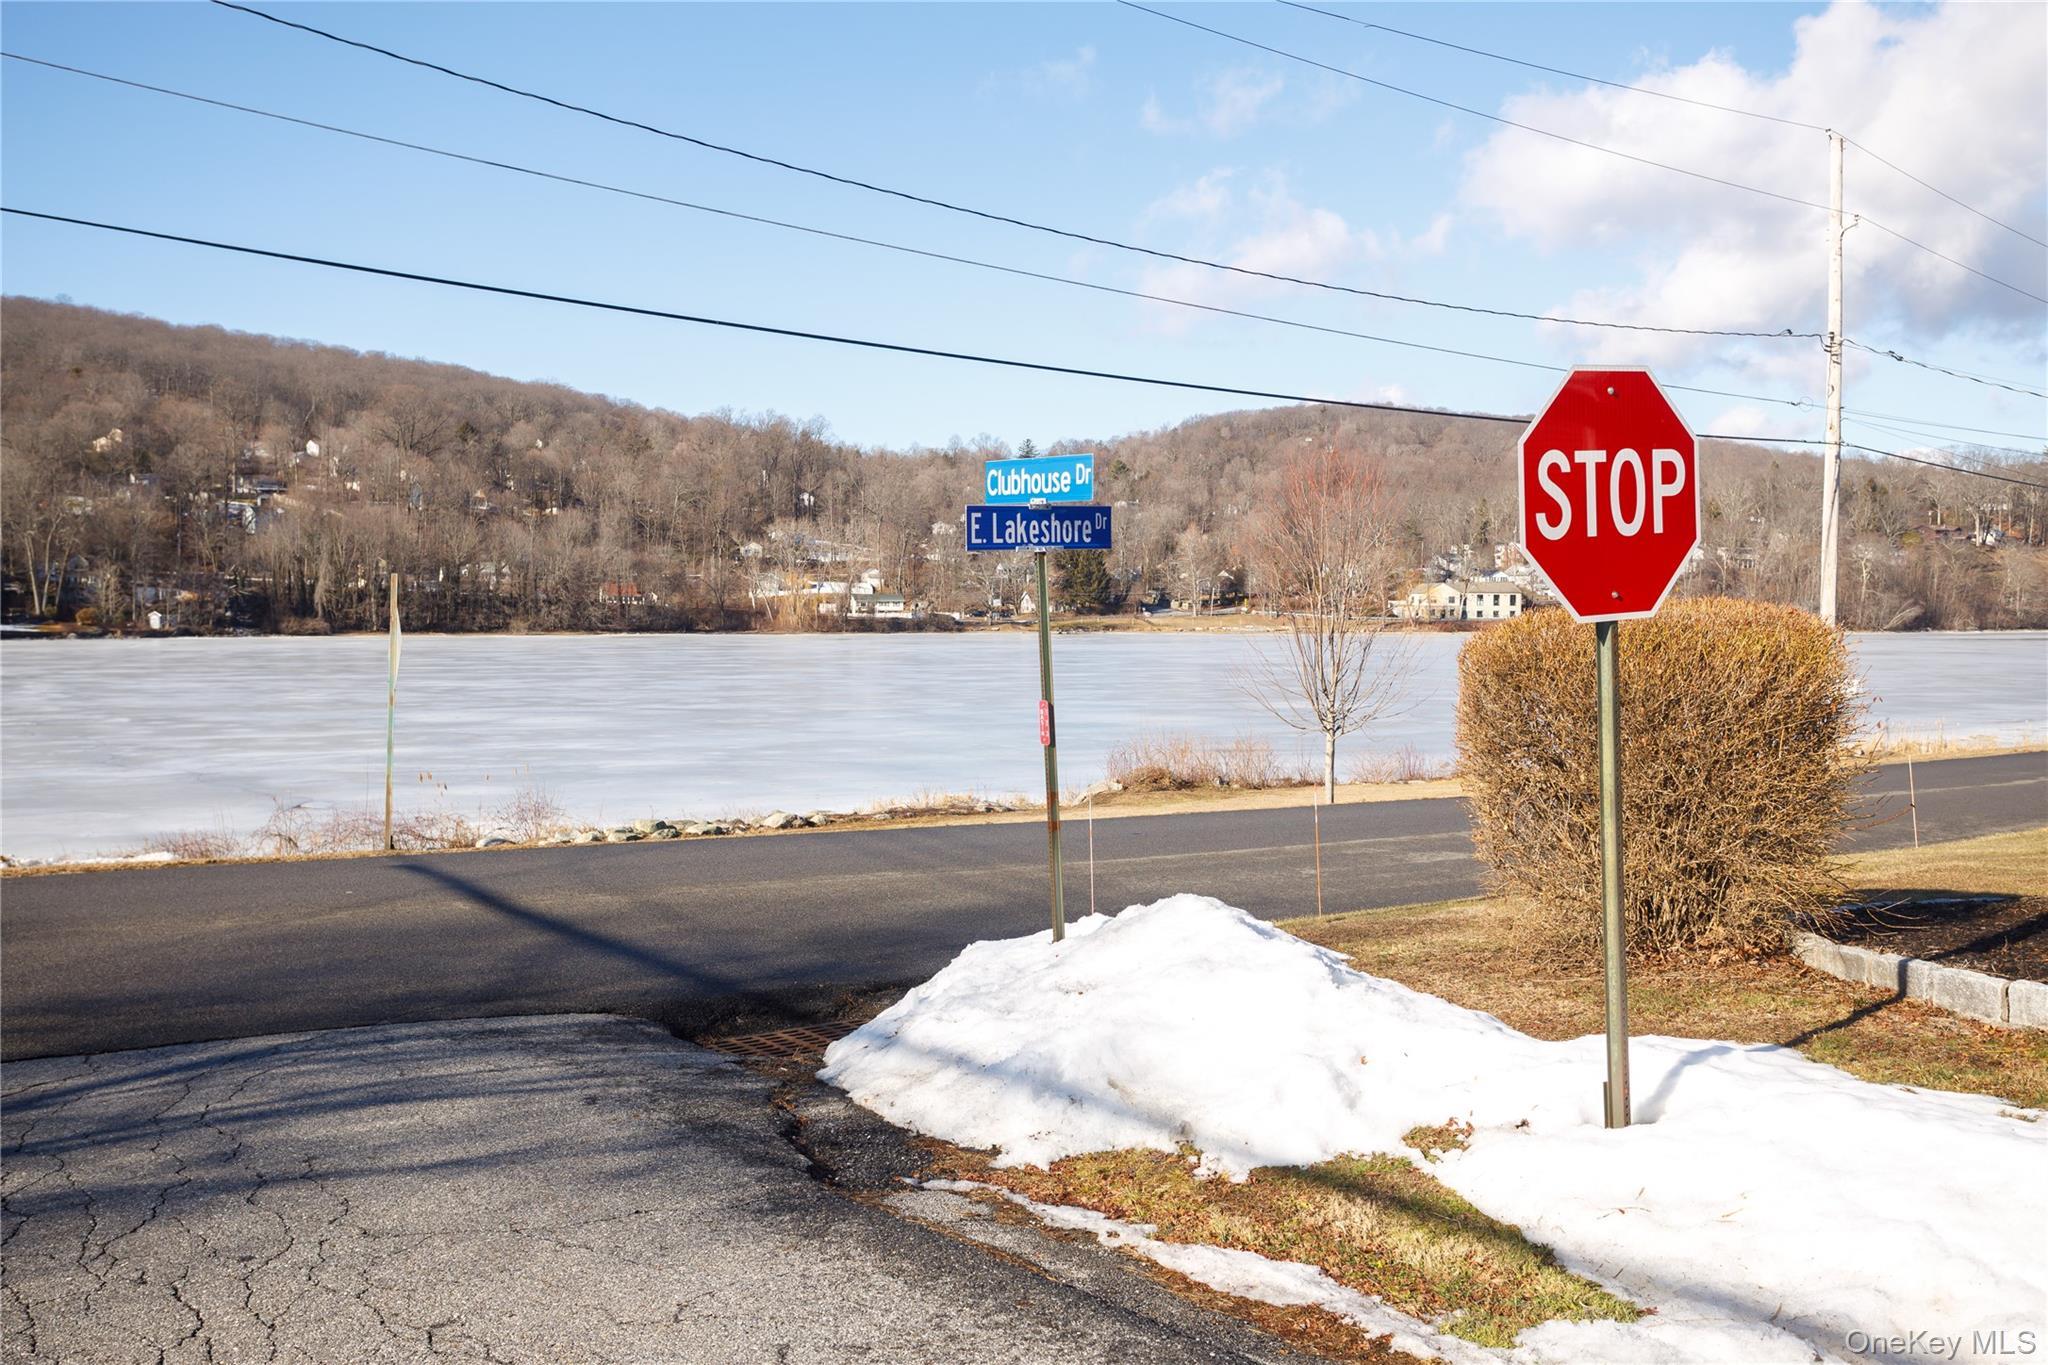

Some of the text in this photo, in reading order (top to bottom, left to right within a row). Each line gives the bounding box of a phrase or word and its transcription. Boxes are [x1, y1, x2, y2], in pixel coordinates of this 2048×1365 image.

[987, 463, 1092, 496] Clubhouse Dr
[1535, 448, 1686, 540] STOP
[971, 512, 1107, 544] E. Lakeshore Dr
